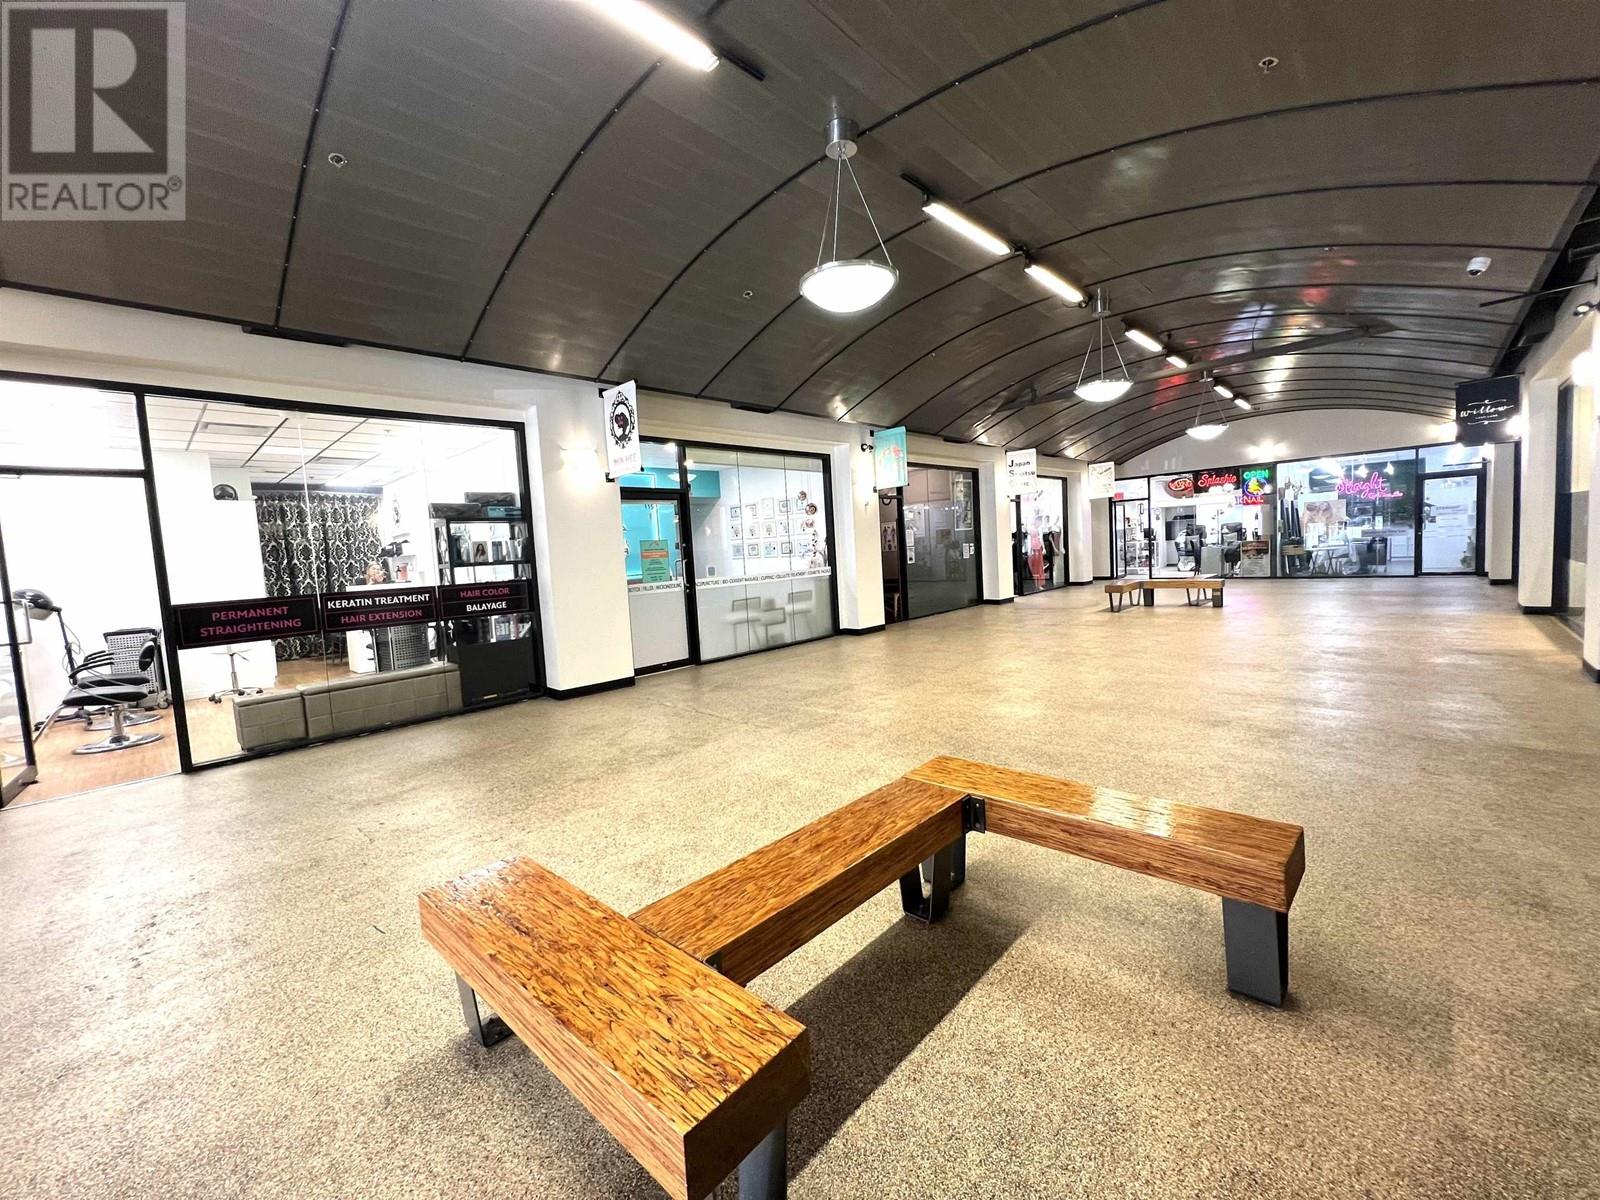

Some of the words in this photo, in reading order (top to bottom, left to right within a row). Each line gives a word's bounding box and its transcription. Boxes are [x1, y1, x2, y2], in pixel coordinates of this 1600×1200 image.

[1243, 469, 1269, 480] OPEN
[460, 588, 481, 598] HAIR
[482, 587, 510, 597] COLOR
[327, 597, 373, 609] KERATIN
[374, 593, 430, 605] TREATMENT
[466, 601, 507, 612] BALAYAGE
[211, 606, 289, 621] PERMANENT
[340, 614, 366, 624] HAIR
[368, 609, 423, 622] EXTENSION
[200, 618, 302, 637] STRAIGHTENING
